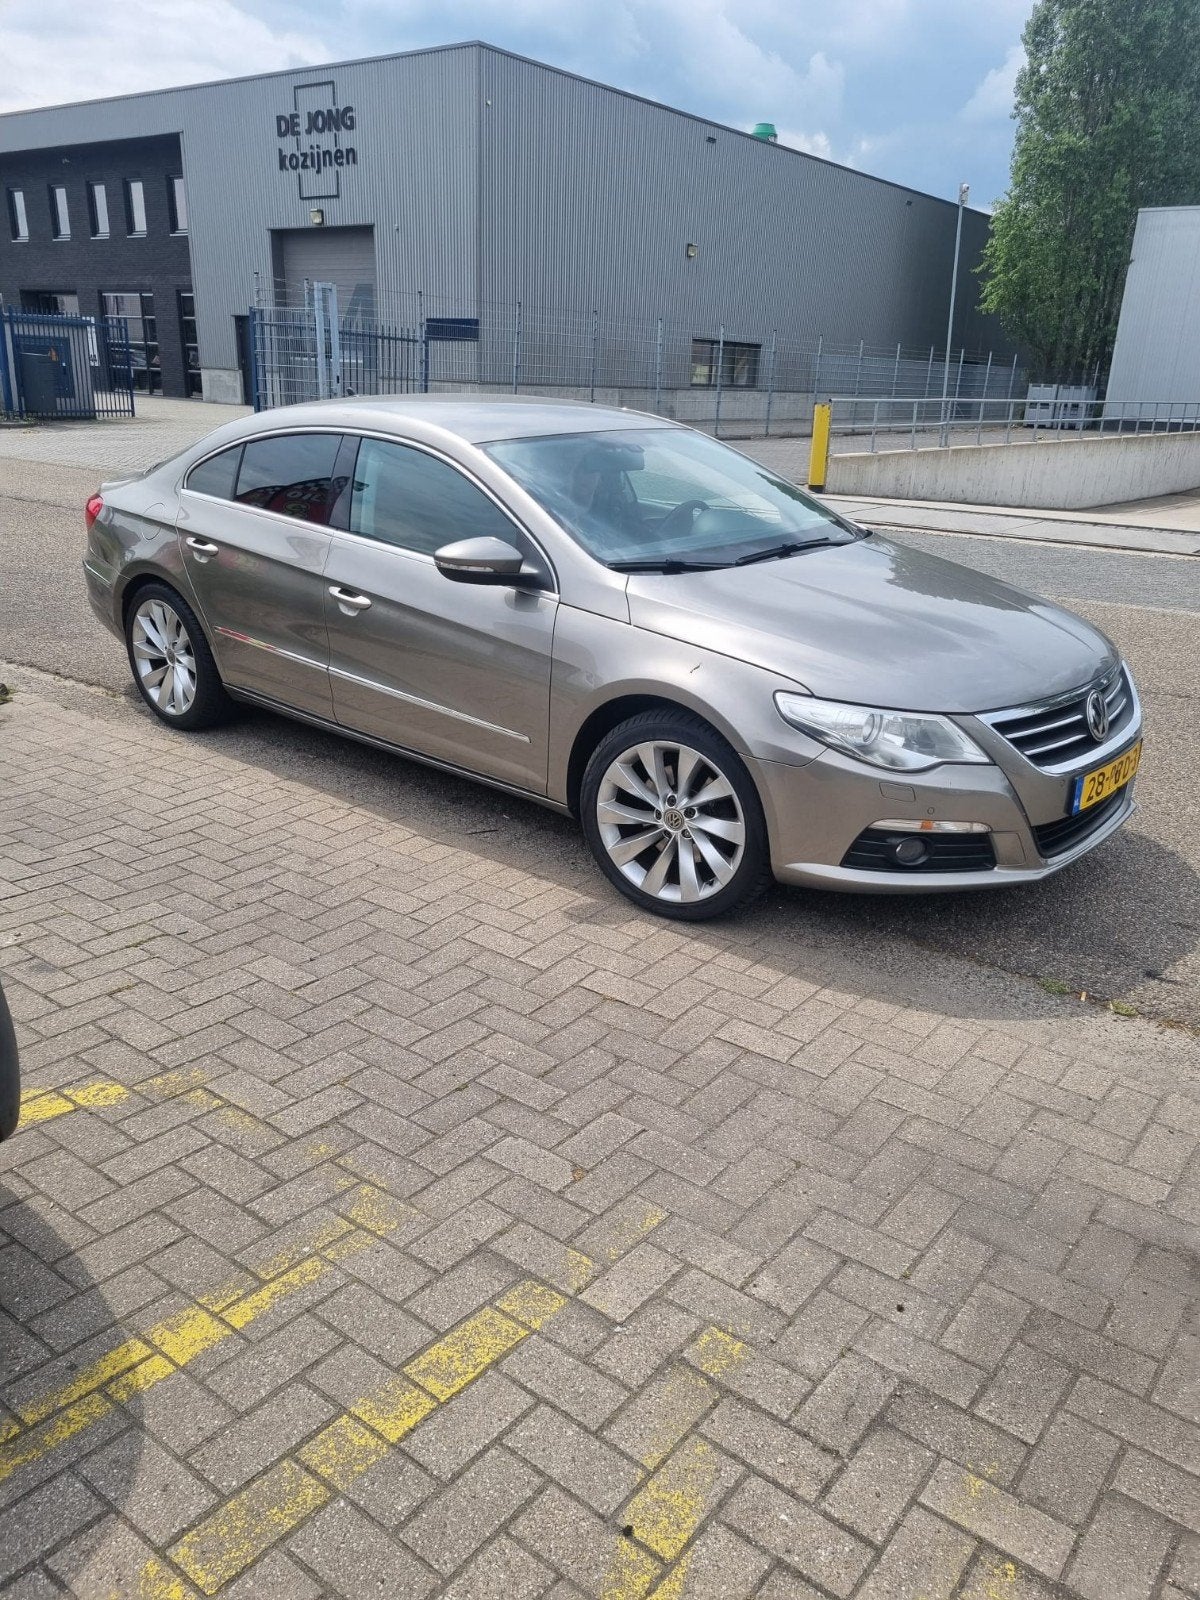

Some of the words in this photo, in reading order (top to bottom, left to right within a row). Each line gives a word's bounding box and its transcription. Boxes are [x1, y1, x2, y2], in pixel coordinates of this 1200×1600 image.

[276, 112, 300, 138] DE
[305, 105, 355, 135] JONG
[278, 144, 357, 174] kozijnen
